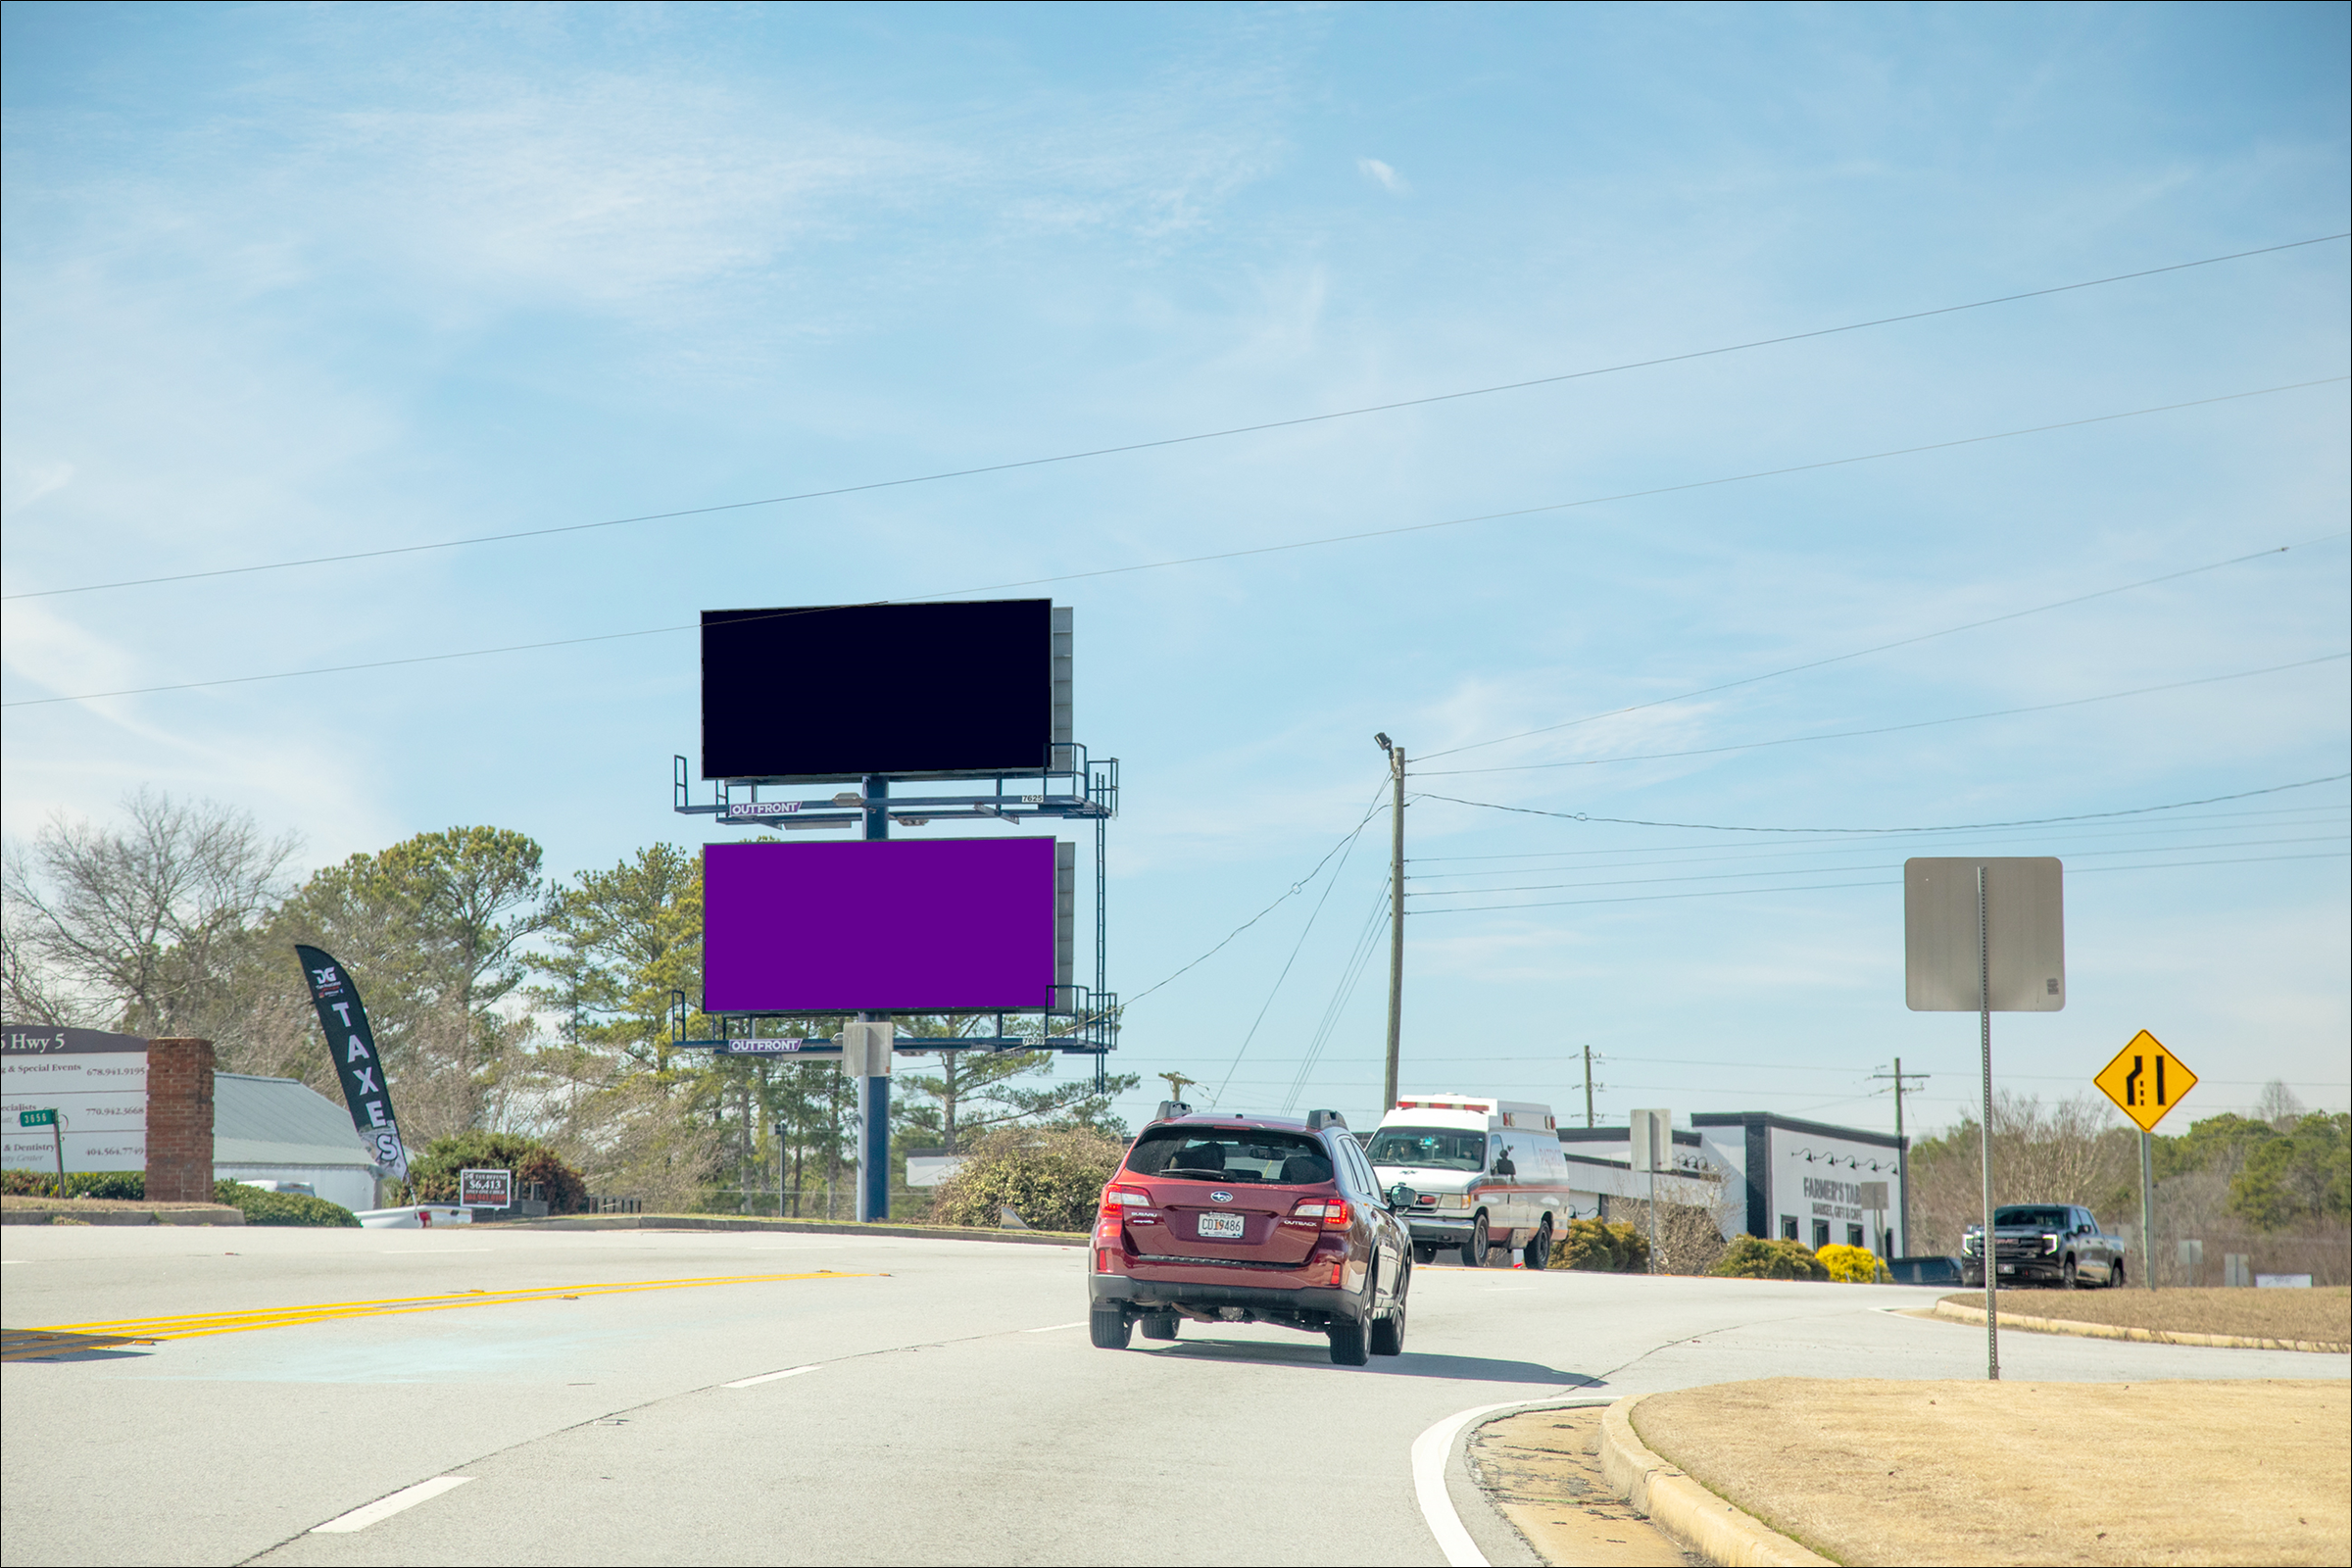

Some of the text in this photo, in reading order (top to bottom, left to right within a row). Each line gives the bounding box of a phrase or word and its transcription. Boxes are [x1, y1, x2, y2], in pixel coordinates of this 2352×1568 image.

[732, 803, 798, 815] OUTFRONT
[11, 1033, 51, 1054] Hwy
[55, 1033, 65, 1050] 5
[731, 1040, 798, 1051] OUTFRONT
[18, 1064, 50, 1074] Special
[86, 1067, 146, 1076] 678.941.9195
[331, 1002, 398, 1161] TAXES
[24, 1113, 47, 1124] 3656
[14, 1144, 55, 1152] Dentistry
[469, 1179, 501, 1190] $6,413
[1803, 1177, 1862, 1205] FARMER'S TAB
[1201, 1218, 1242, 1232] CDI9486
